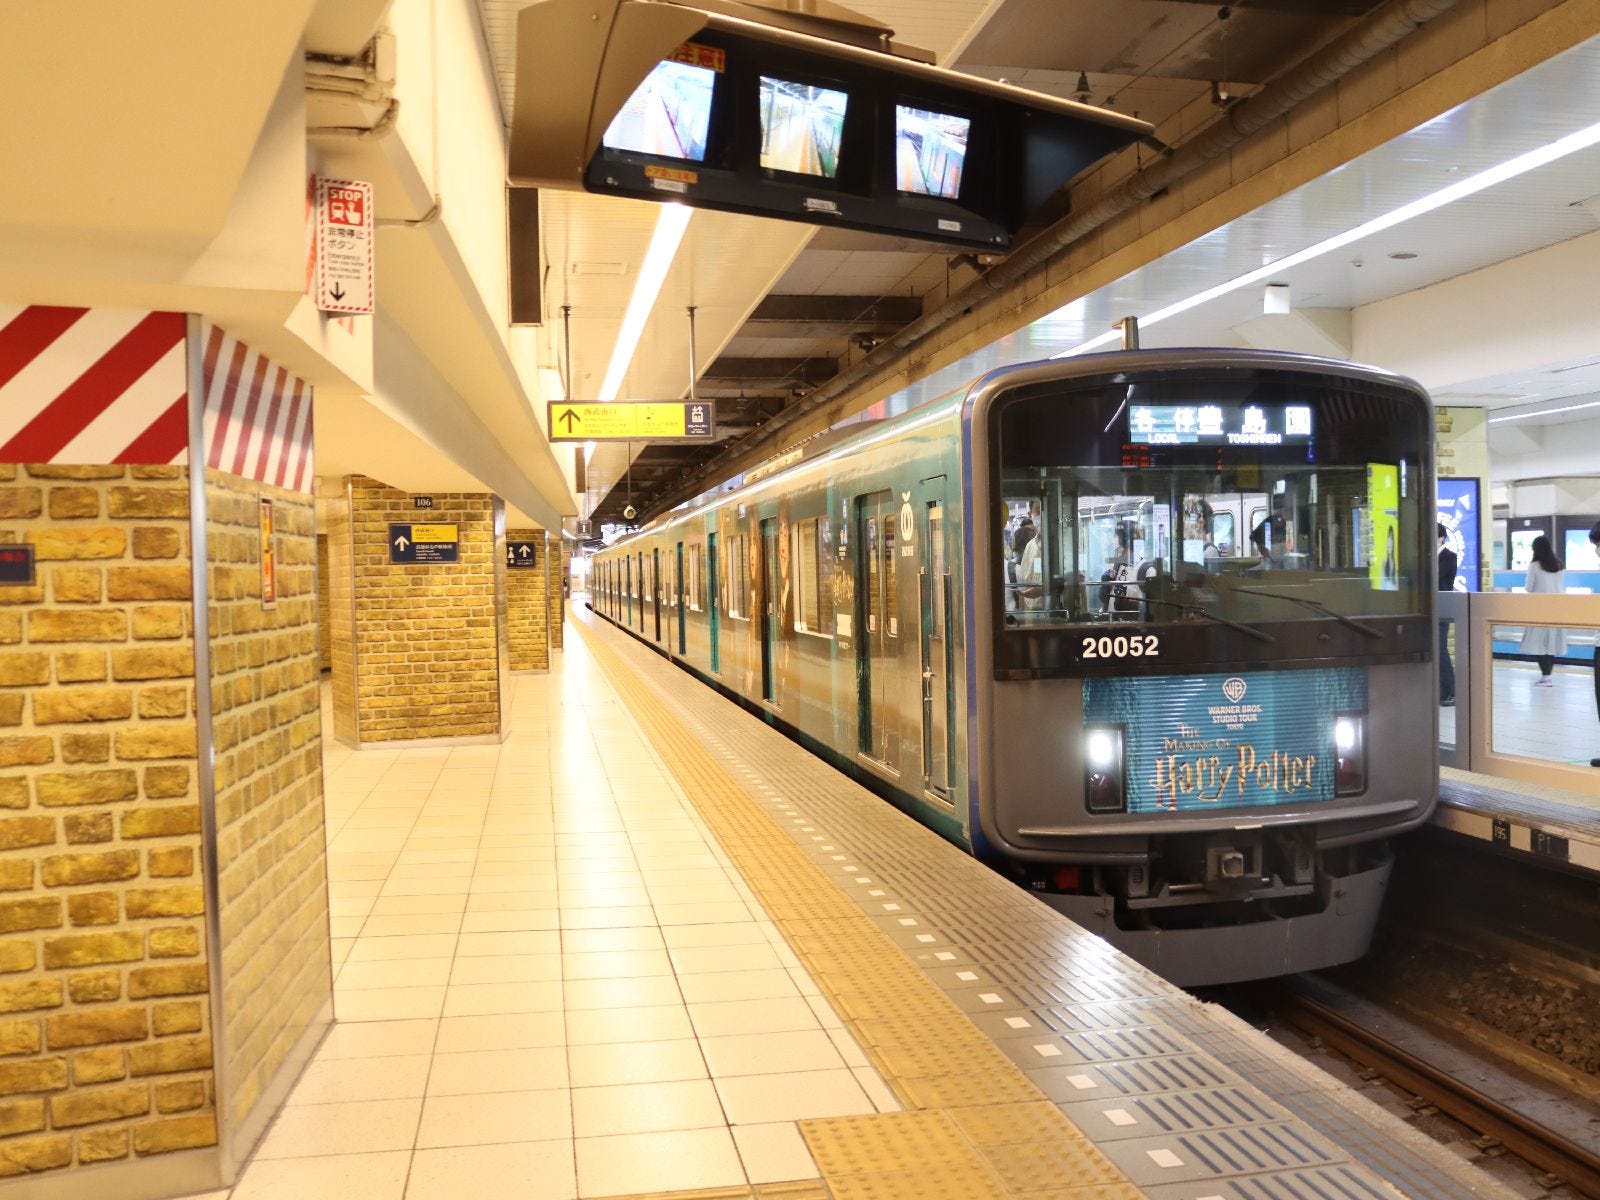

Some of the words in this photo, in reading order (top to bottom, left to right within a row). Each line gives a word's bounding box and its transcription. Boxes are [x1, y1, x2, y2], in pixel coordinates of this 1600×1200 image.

[329, 189, 362, 202] STOP
[328, 227, 365, 240] 非常停止
[328, 240, 355, 250] ボタン
[416, 498, 432, 507] 106
[1082, 635, 1160, 658] 20052
[1207, 706, 1241, 715] WARNER
[1241, 704, 1263, 714] BROS.
[1212, 714, 1238, 723] STUDIO
[1238, 713, 1258, 723] TOUR
[1149, 753, 1234, 812] Harry
[1236, 742, 1317, 800] Potter
